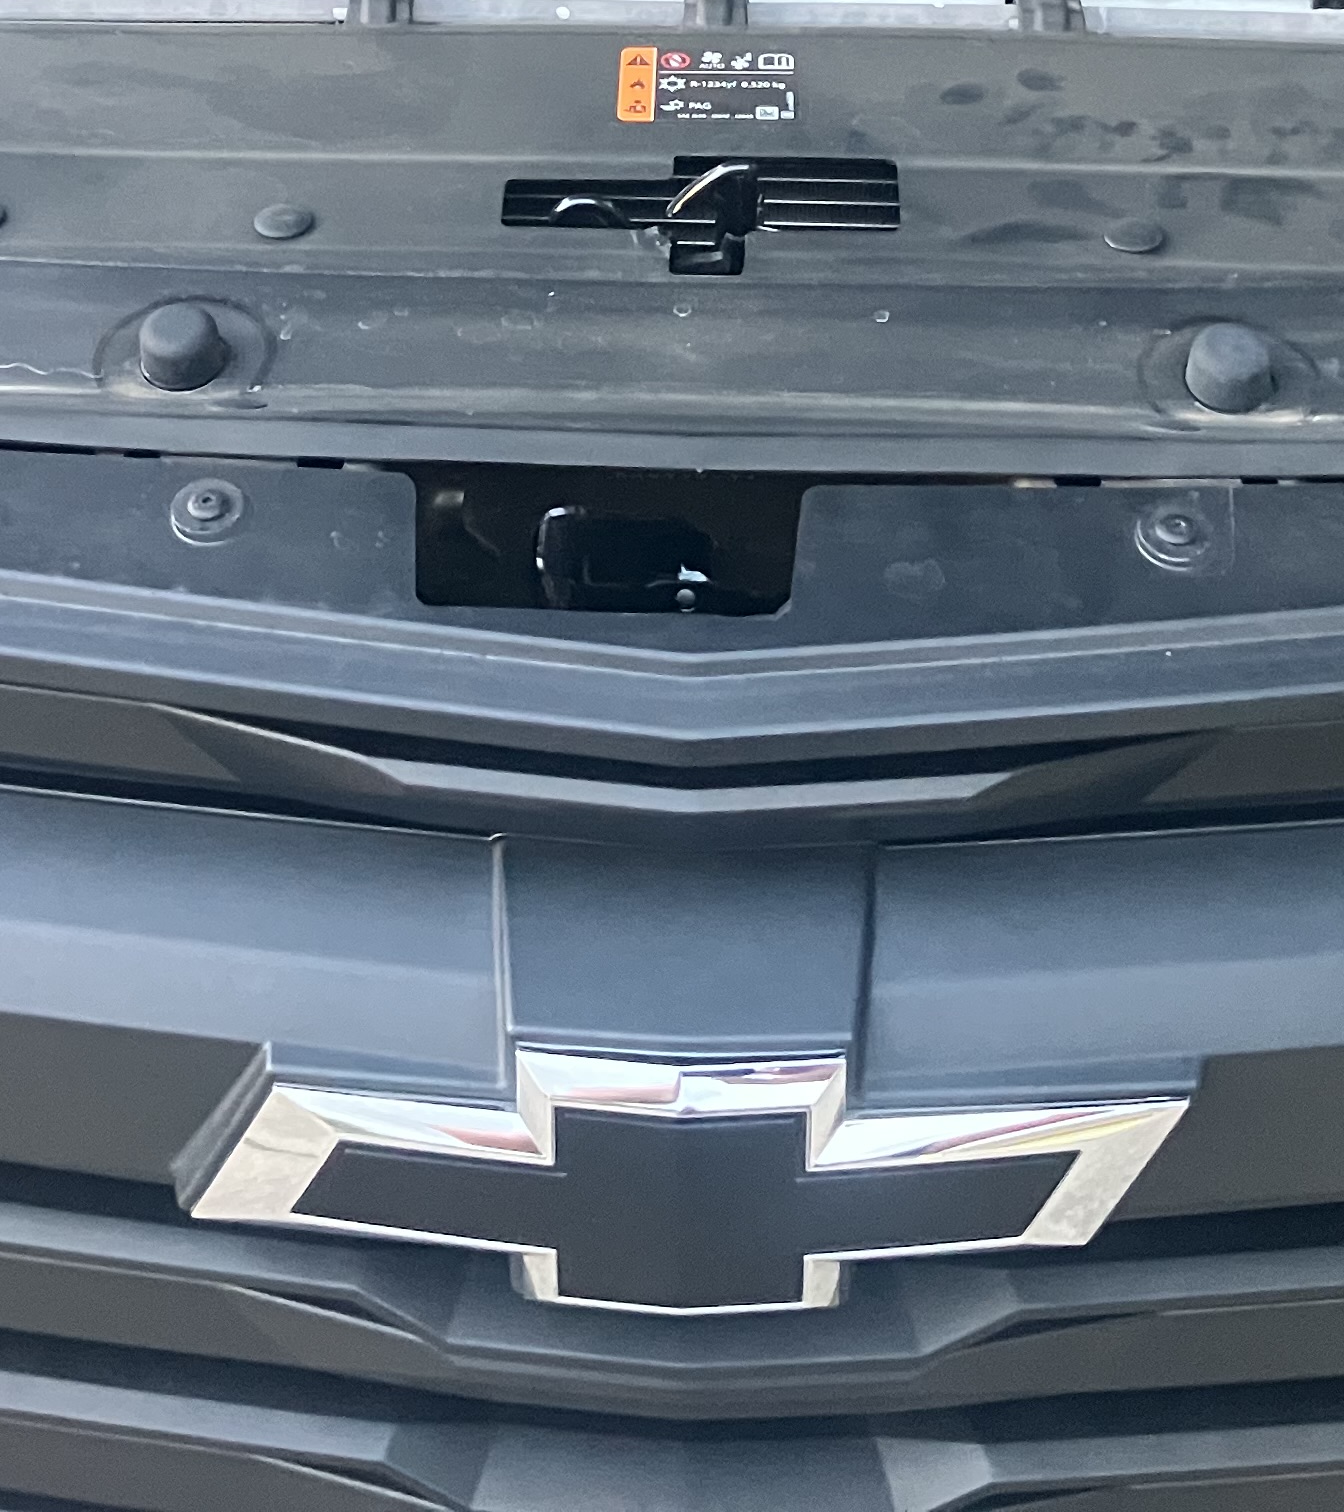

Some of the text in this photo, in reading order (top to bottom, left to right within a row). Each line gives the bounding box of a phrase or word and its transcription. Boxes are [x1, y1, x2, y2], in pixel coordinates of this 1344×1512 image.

[689, 80, 737, 89] R-1234yf
[771, 81, 786, 90] kg
[688, 101, 712, 110] PAG
